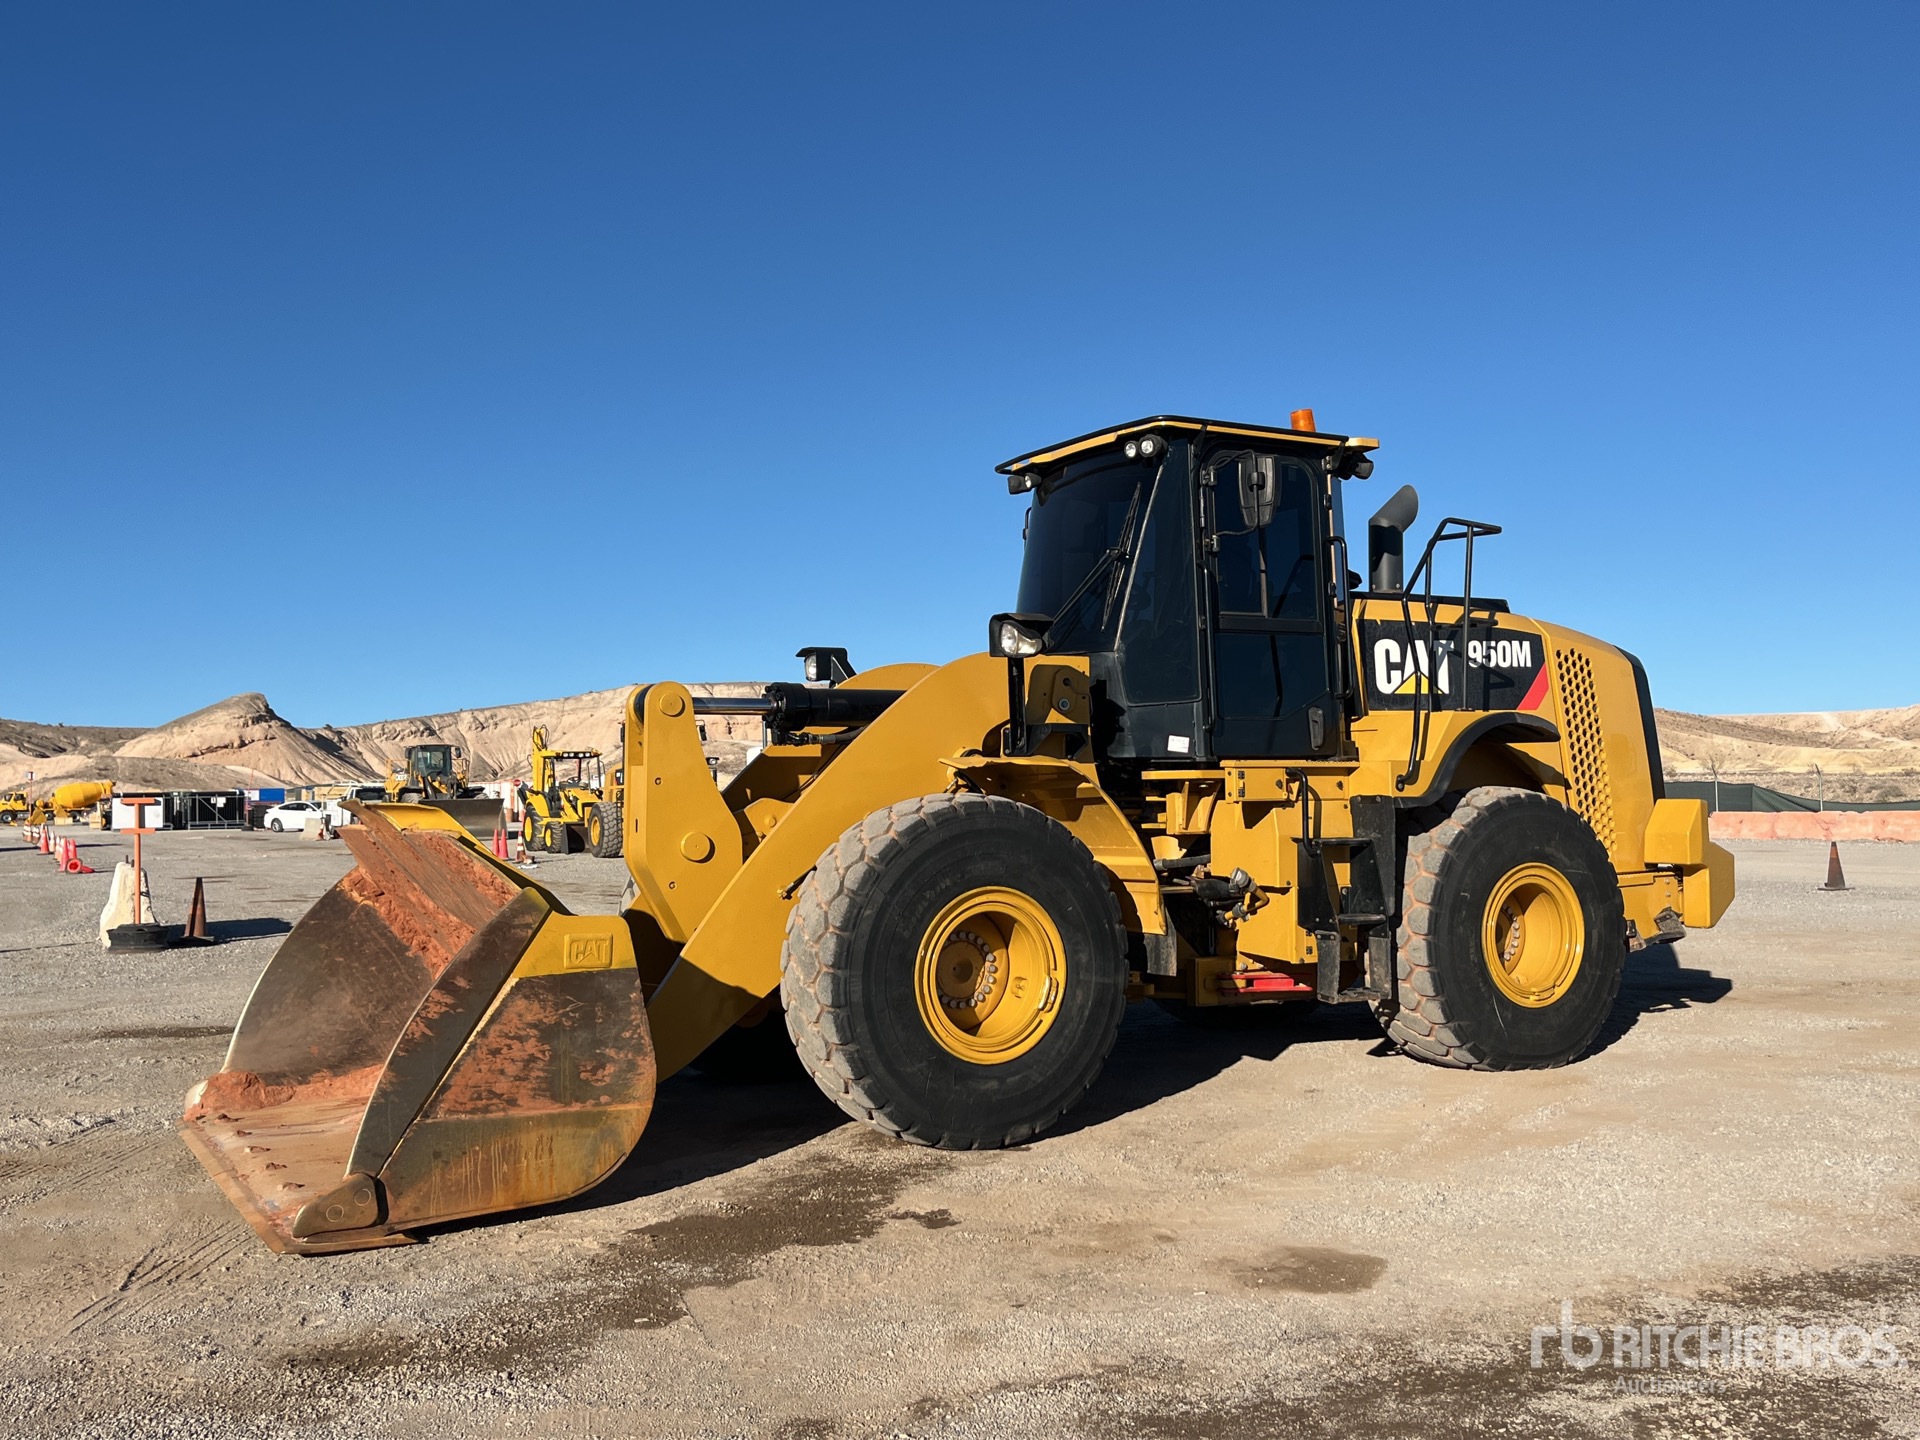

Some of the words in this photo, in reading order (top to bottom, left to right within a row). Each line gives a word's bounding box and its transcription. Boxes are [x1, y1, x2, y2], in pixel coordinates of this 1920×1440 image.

[1374, 638, 1455, 695] CAT
[1467, 640, 1532, 668] 950M
[570, 939, 609, 964] CAT
